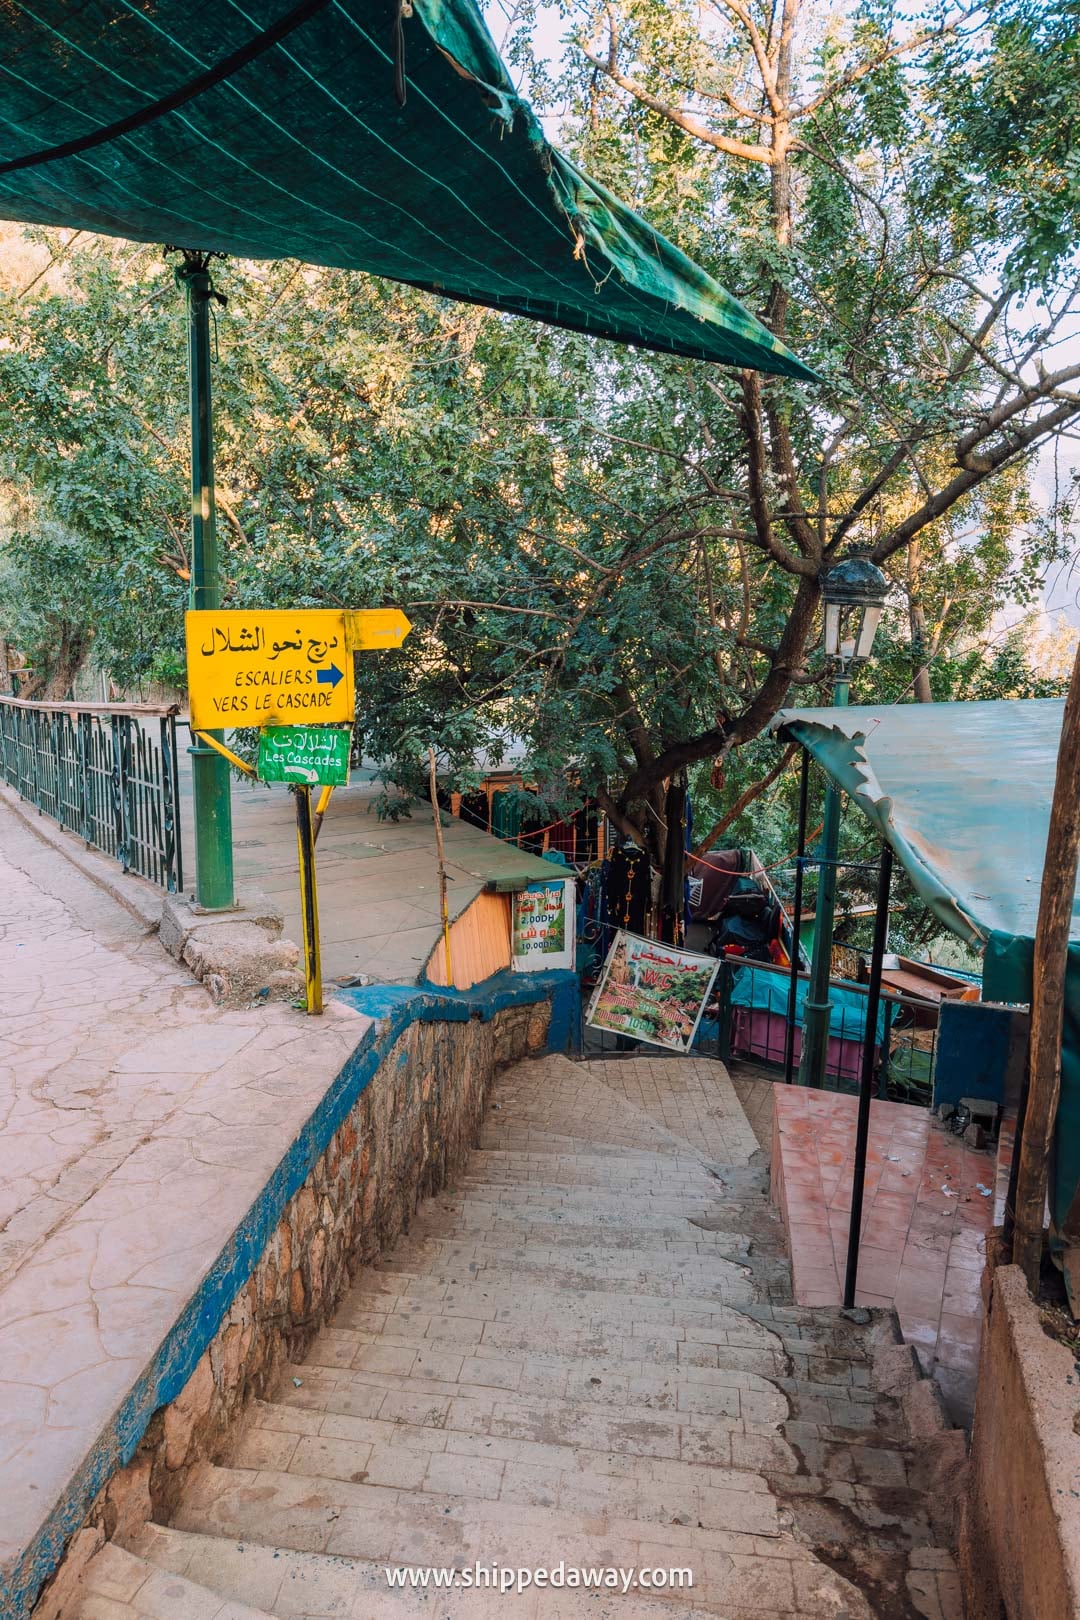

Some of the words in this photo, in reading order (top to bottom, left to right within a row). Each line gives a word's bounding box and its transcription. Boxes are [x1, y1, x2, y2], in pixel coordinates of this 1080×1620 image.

[201, 626, 266, 657] الشلال
[267, 628, 303, 661] نحو
[307, 635, 339, 664] درج
[235, 669, 313, 687] ESCALIERS
[213, 695, 248, 712] VERS
[255, 694, 271, 710] LE
[276, 691, 333, 709] CASCADE
[265, 750, 284, 762] Les
[287, 751, 342, 767] Cascades
[631, 946, 698, 973] مراحيض
